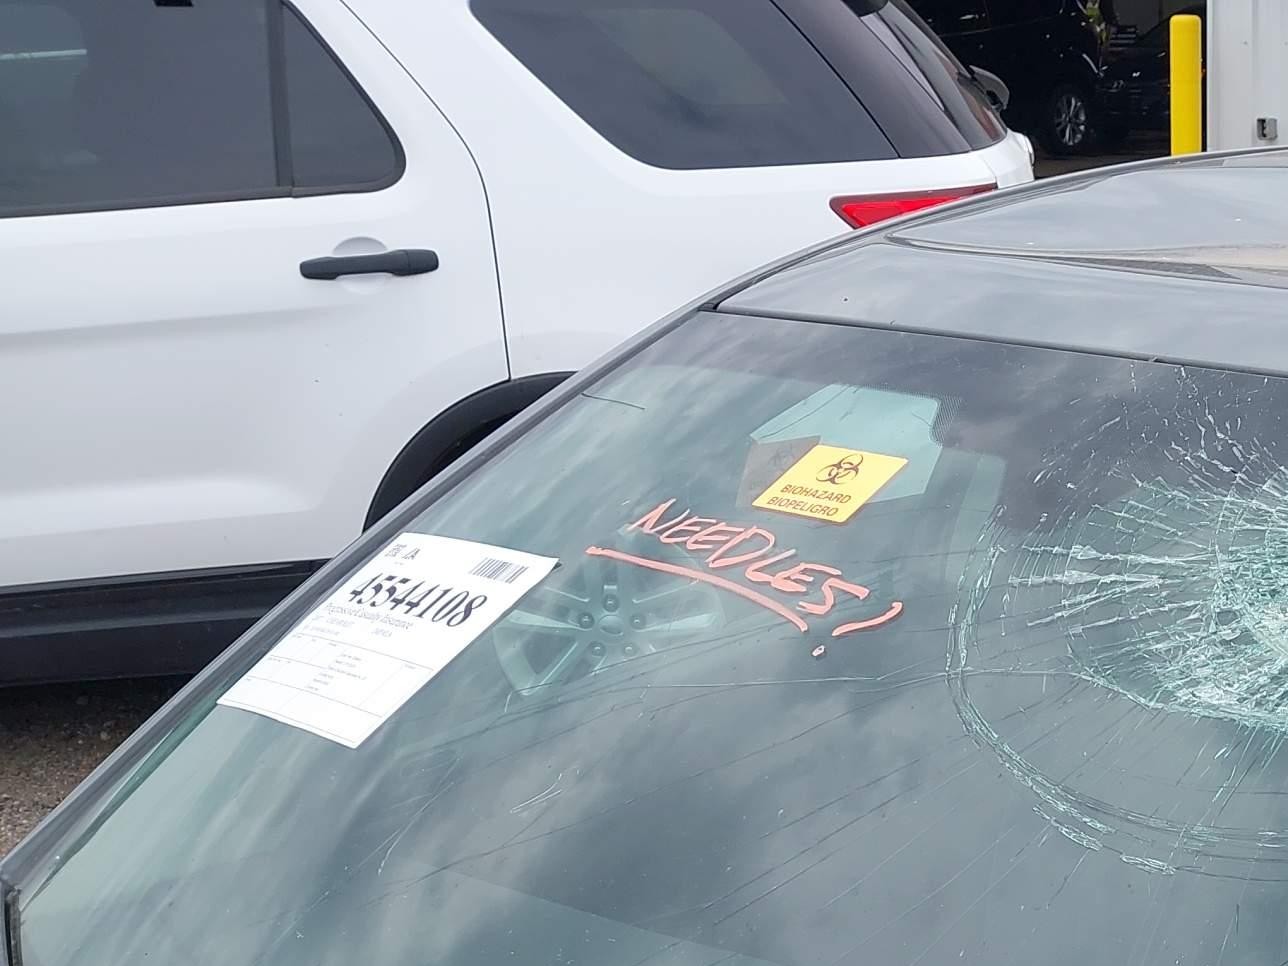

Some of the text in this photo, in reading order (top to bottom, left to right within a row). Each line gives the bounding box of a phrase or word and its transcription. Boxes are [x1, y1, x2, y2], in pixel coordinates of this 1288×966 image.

[780, 484, 851, 504] BIOHAZARD
[767, 496, 838, 517] BIOPELIGRO
[348, 572, 487, 627] 45544108
